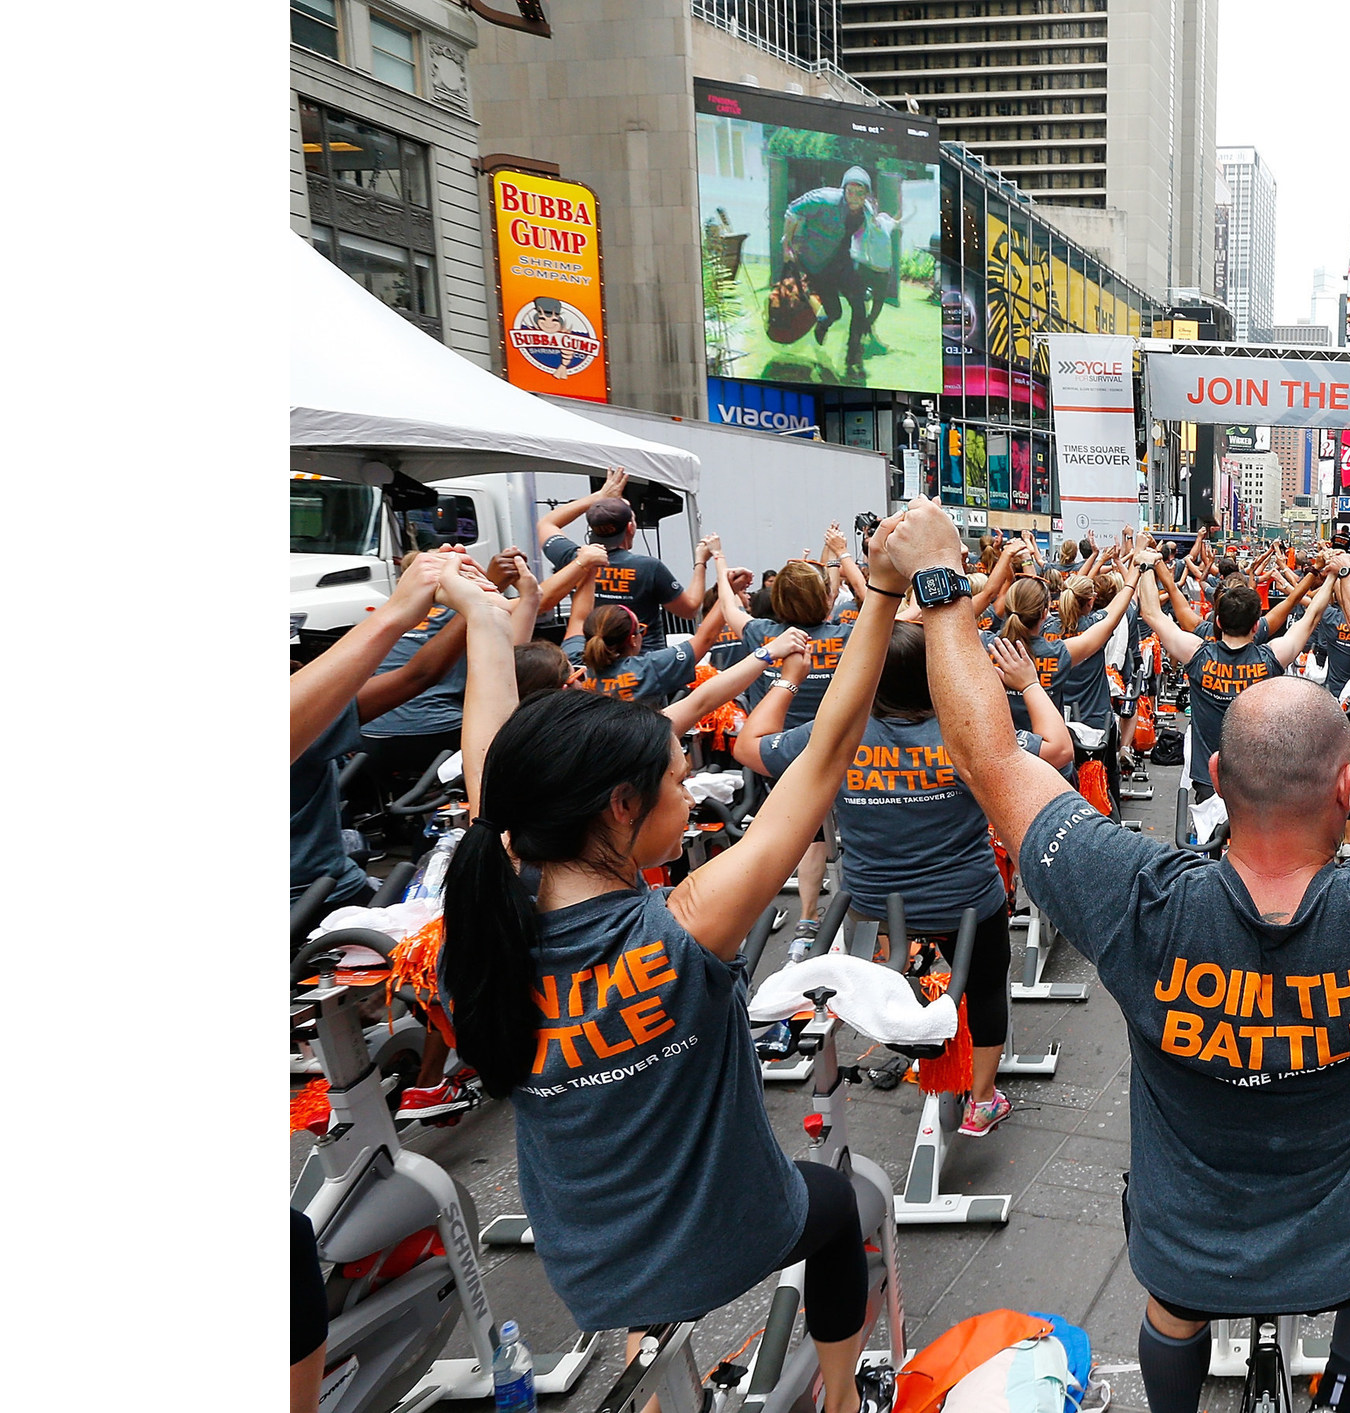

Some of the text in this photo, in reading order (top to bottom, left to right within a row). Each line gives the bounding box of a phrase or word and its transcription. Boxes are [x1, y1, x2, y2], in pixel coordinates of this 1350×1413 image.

[500, 182, 592, 226] BUBBA
[511, 218, 587, 255] GUMP
[519, 256, 583, 272] SHRIMP
[511, 266, 592, 286] COMPANY
[513, 331, 598, 352] BUBBA GUMP
[1074, 360, 1123, 376] CYCLE
[1089, 375, 1122, 383] SURVIVAL
[1187, 376, 1268, 407] JOIN
[1280, 380, 1350, 411] THE
[1064, 445, 1126, 454] TIMES SQUARE
[1063, 454, 1130, 466] TAKEOVER
[604, 567, 637, 581] THE
[1202, 660, 1268, 679] JOIN THE
[847, 768, 957, 791] BATTLE
[867, 796, 902, 805] SQUARE
[903, 793, 945, 804] TAKEOVER
[568, 940, 678, 1018] THE
[1154, 956, 1275, 1019] JOIN
[567, 1034, 699, 1089] TAKEOVER 2015
[443, 1201, 488, 1321] SCHWINN
